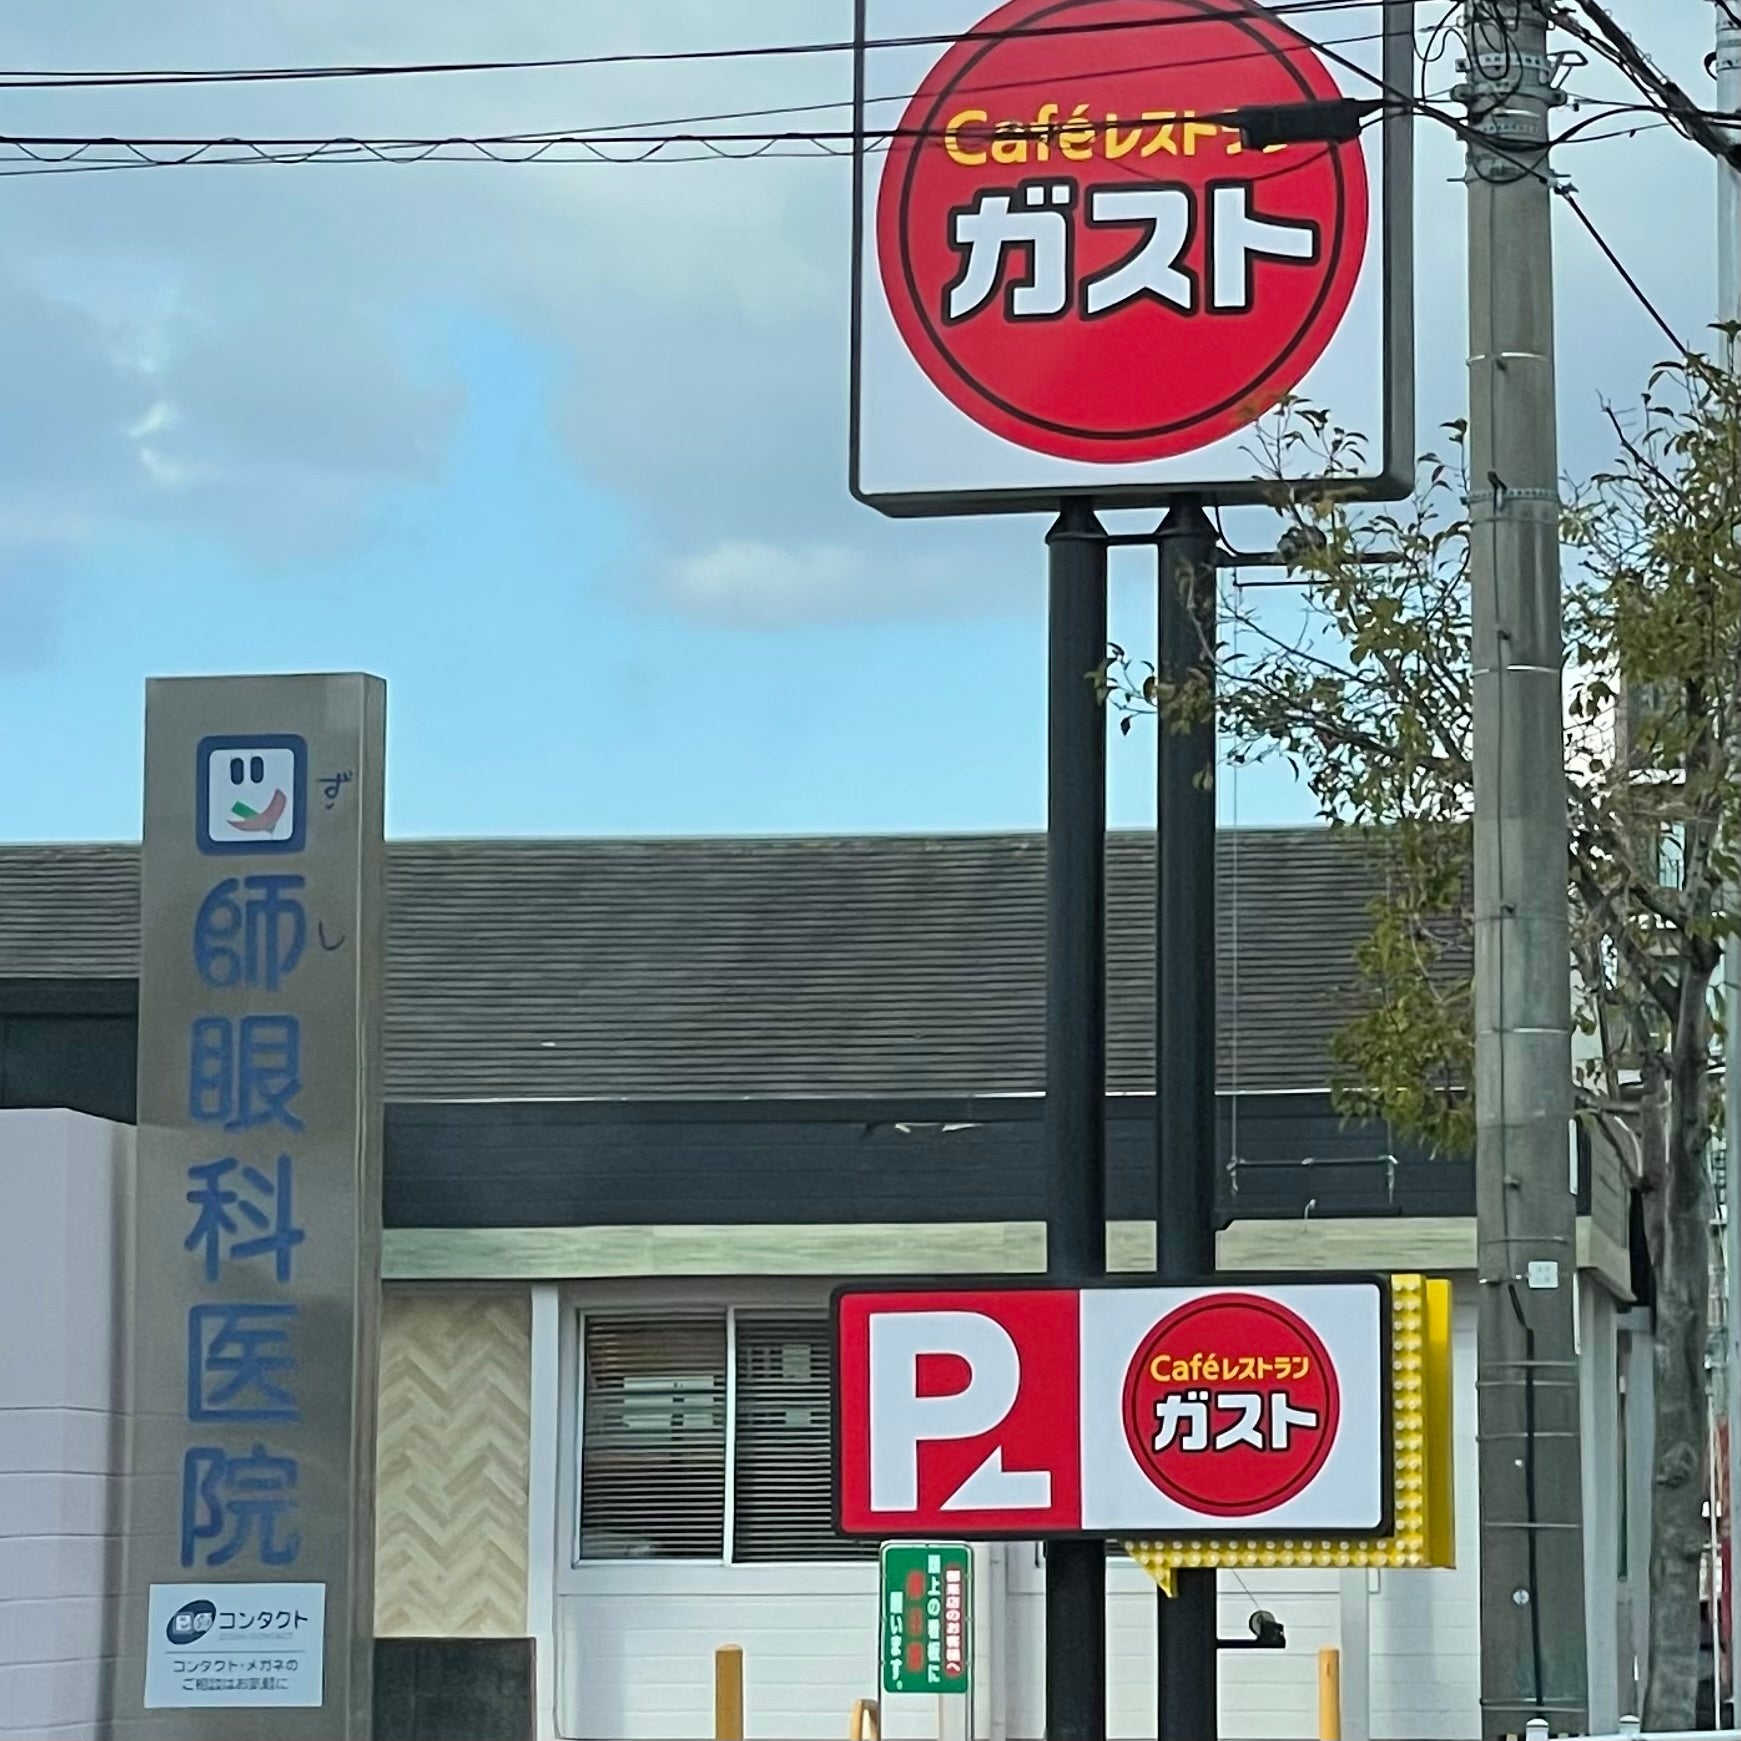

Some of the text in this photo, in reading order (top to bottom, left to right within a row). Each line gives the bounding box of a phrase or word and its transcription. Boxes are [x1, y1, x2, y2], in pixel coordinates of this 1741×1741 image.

[944, 103, 1288, 166] Caféレスト
[946, 182, 1315, 322] ガスト
[181, 874, 307, 1568] 師眼科医院
[1150, 1353, 1310, 1382] Caféレストラン
[869, 1311, 1021, 1512] P
[1153, 1389, 1319, 1452] ガスト
[219, 1610, 308, 1630] コンタクト
